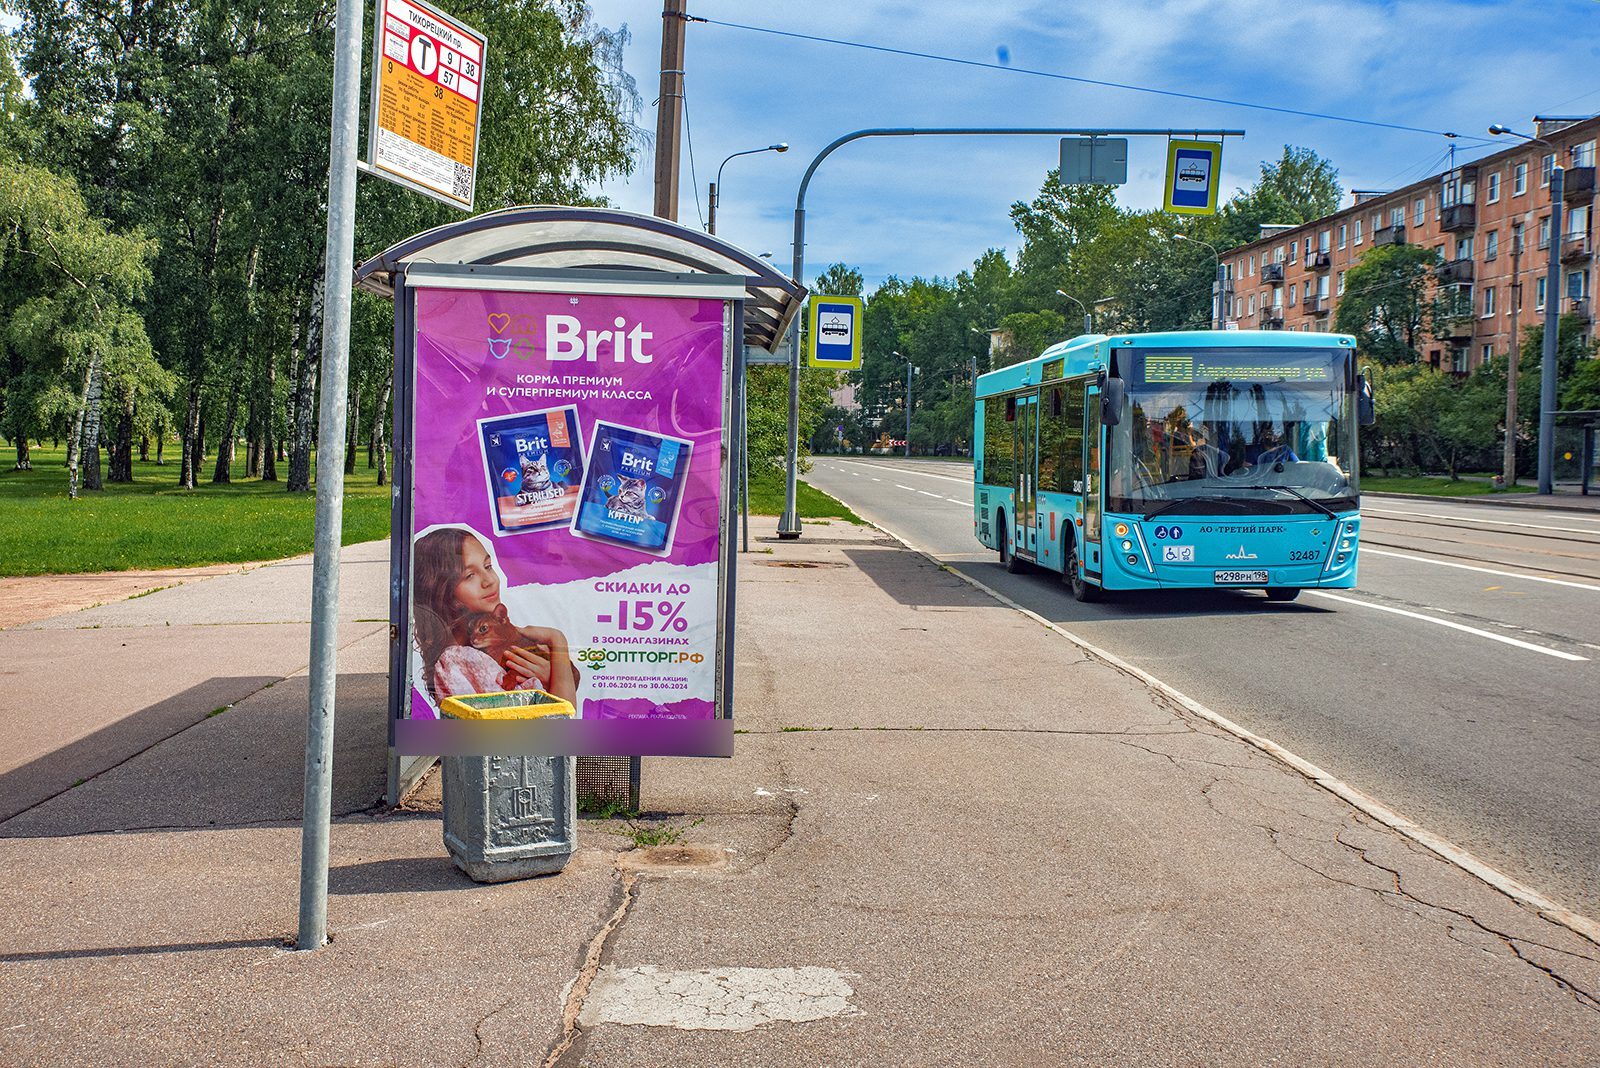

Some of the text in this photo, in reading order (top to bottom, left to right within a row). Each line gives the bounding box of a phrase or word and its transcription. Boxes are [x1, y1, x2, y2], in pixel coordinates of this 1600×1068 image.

[408, 9, 453, 43] ТИХОРЕЦКИЙ
[447, 52, 453, 65] 9
[387, 61, 393, 74] 9
[465, 61, 475, 77] 38
[443, 71, 454, 86] 57
[433, 85, 444, 100] 38
[545, 314, 653, 364] Brit
[516, 374, 623, 386] КОРМА ПРЕМИУМ
[486, 387, 653, 400] И СУПЕРПРЕМИУМ КЛАССА
[515, 436, 548, 453] Brit
[621, 452, 654, 472] Brit
[516, 487, 565, 504] STERILISED
[1199, 525, 1213, 534] АО
[1289, 550, 1320, 561] 32487
[594, 581, 691, 595] СКИДКИ ДО
[596, 600, 688, 632] -15%
[592, 636, 690, 645] В ЗООМАГАЗИНАХ
